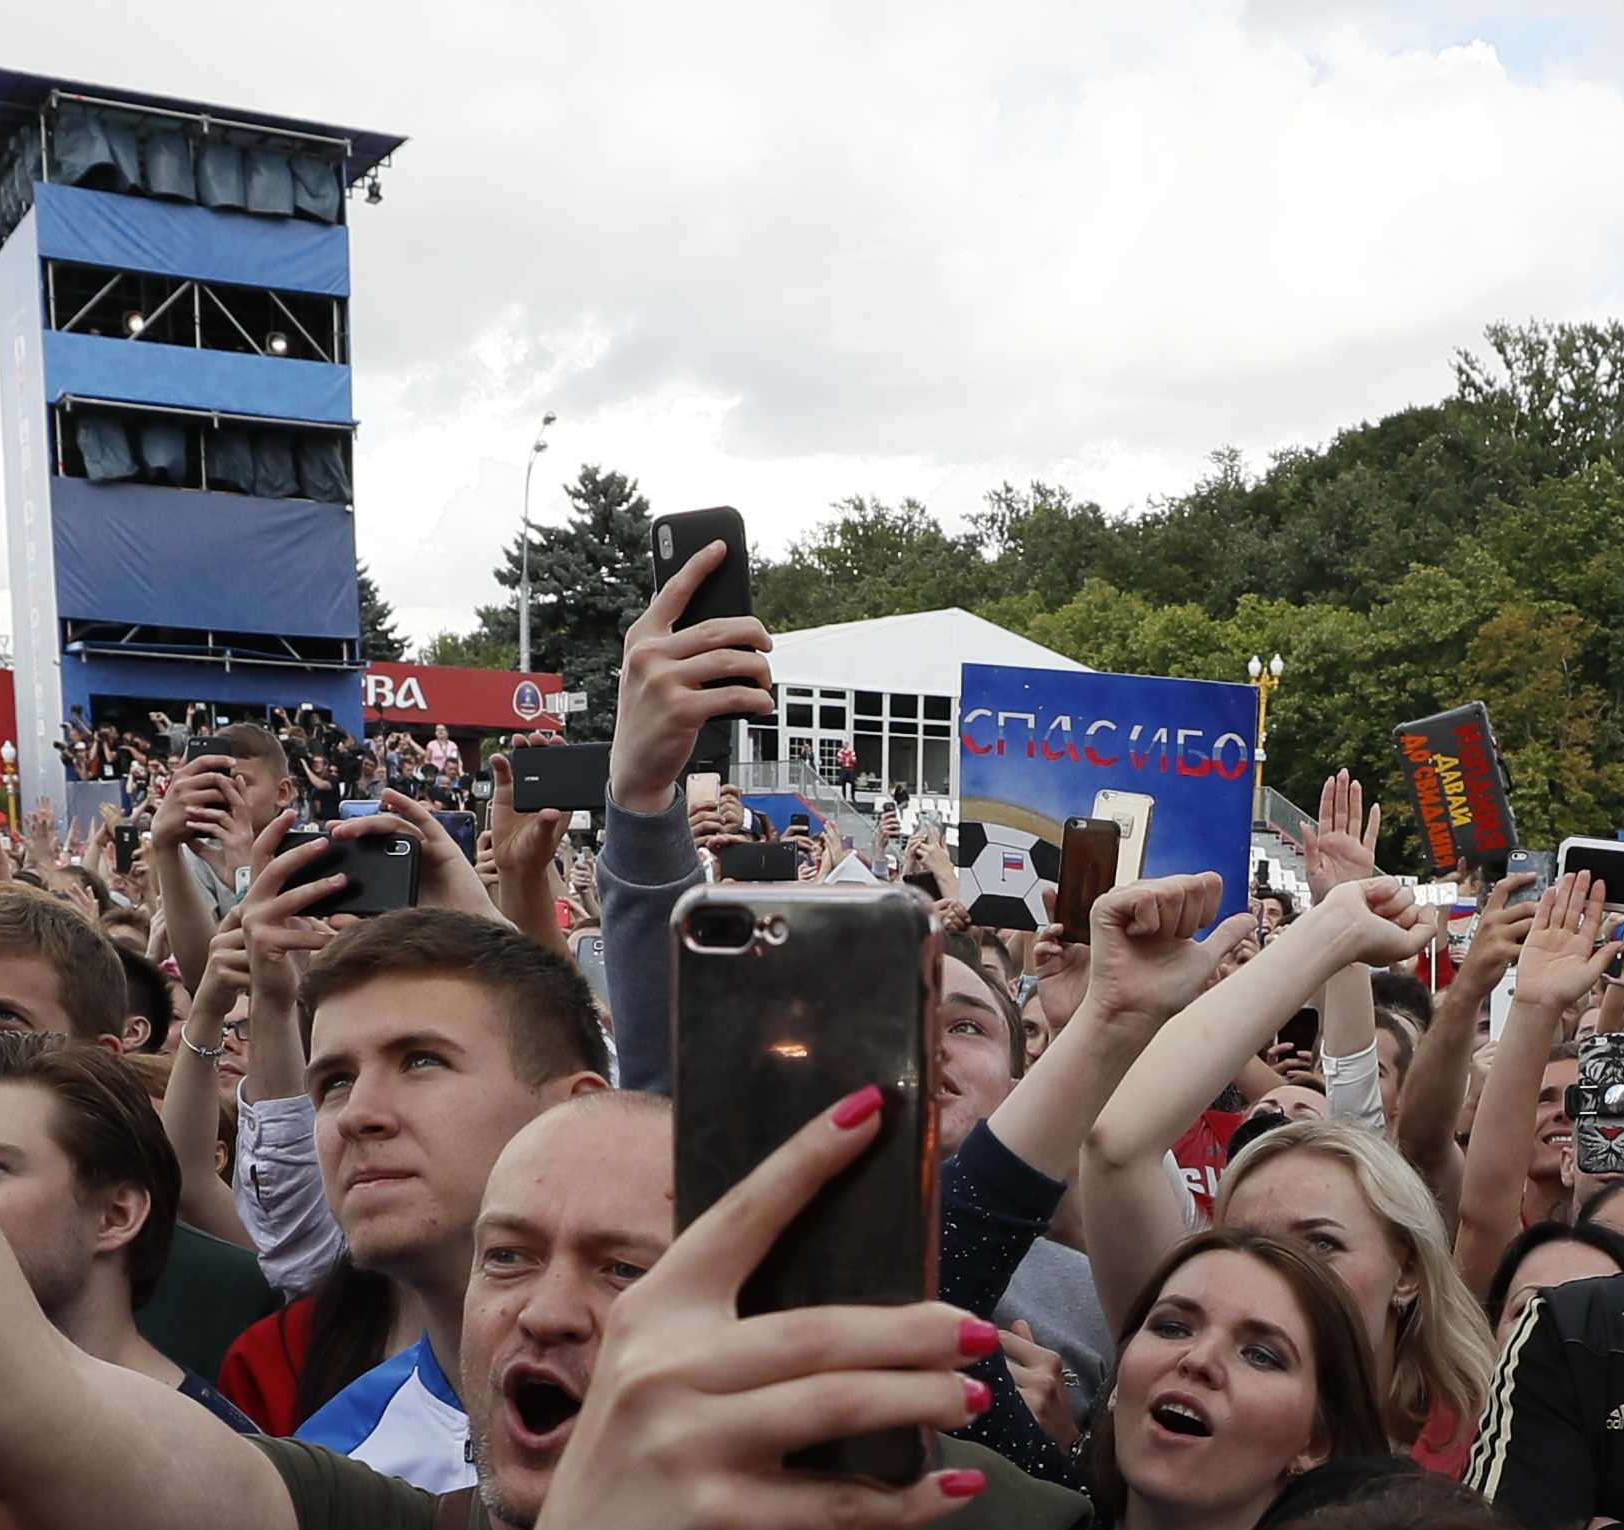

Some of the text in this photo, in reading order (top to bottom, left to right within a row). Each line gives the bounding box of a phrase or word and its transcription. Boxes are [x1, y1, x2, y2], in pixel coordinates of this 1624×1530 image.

[361, 674, 428, 710] ВА
[961, 708, 1248, 778] СПАСИБО
[1399, 735, 1458, 868] ДО СВИДАНИЯ
[1432, 753, 1474, 828] ДАВАЙ
[1453, 722, 1507, 851] ИСПАНИЯ
